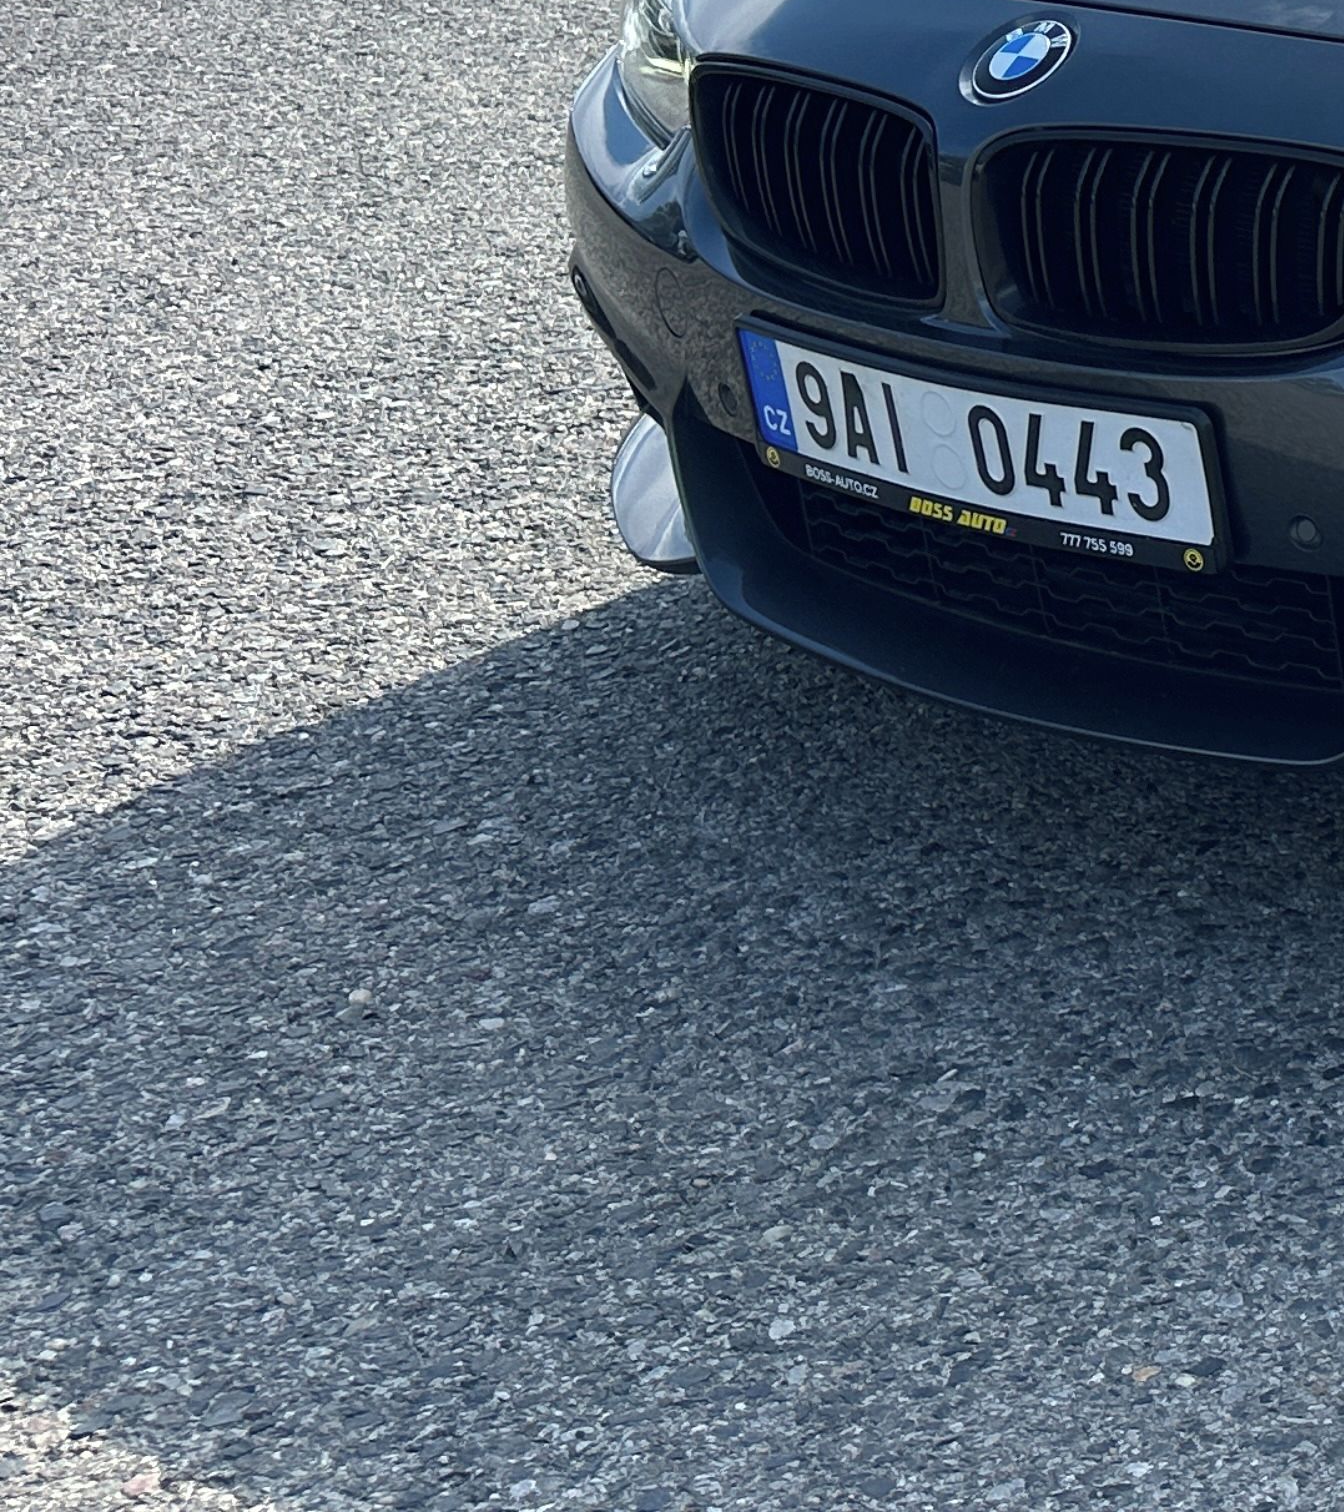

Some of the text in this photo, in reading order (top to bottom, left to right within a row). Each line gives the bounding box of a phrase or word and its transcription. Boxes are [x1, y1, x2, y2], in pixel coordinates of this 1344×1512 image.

[763, 404, 792, 436] CZ
[796, 360, 1171, 522] 9AI 0443
[804, 463, 880, 499] BOSS-AUTO.CZ
[908, 495, 1008, 536] BOSS AUTO
[1060, 532, 1134, 556] 777 755 599
